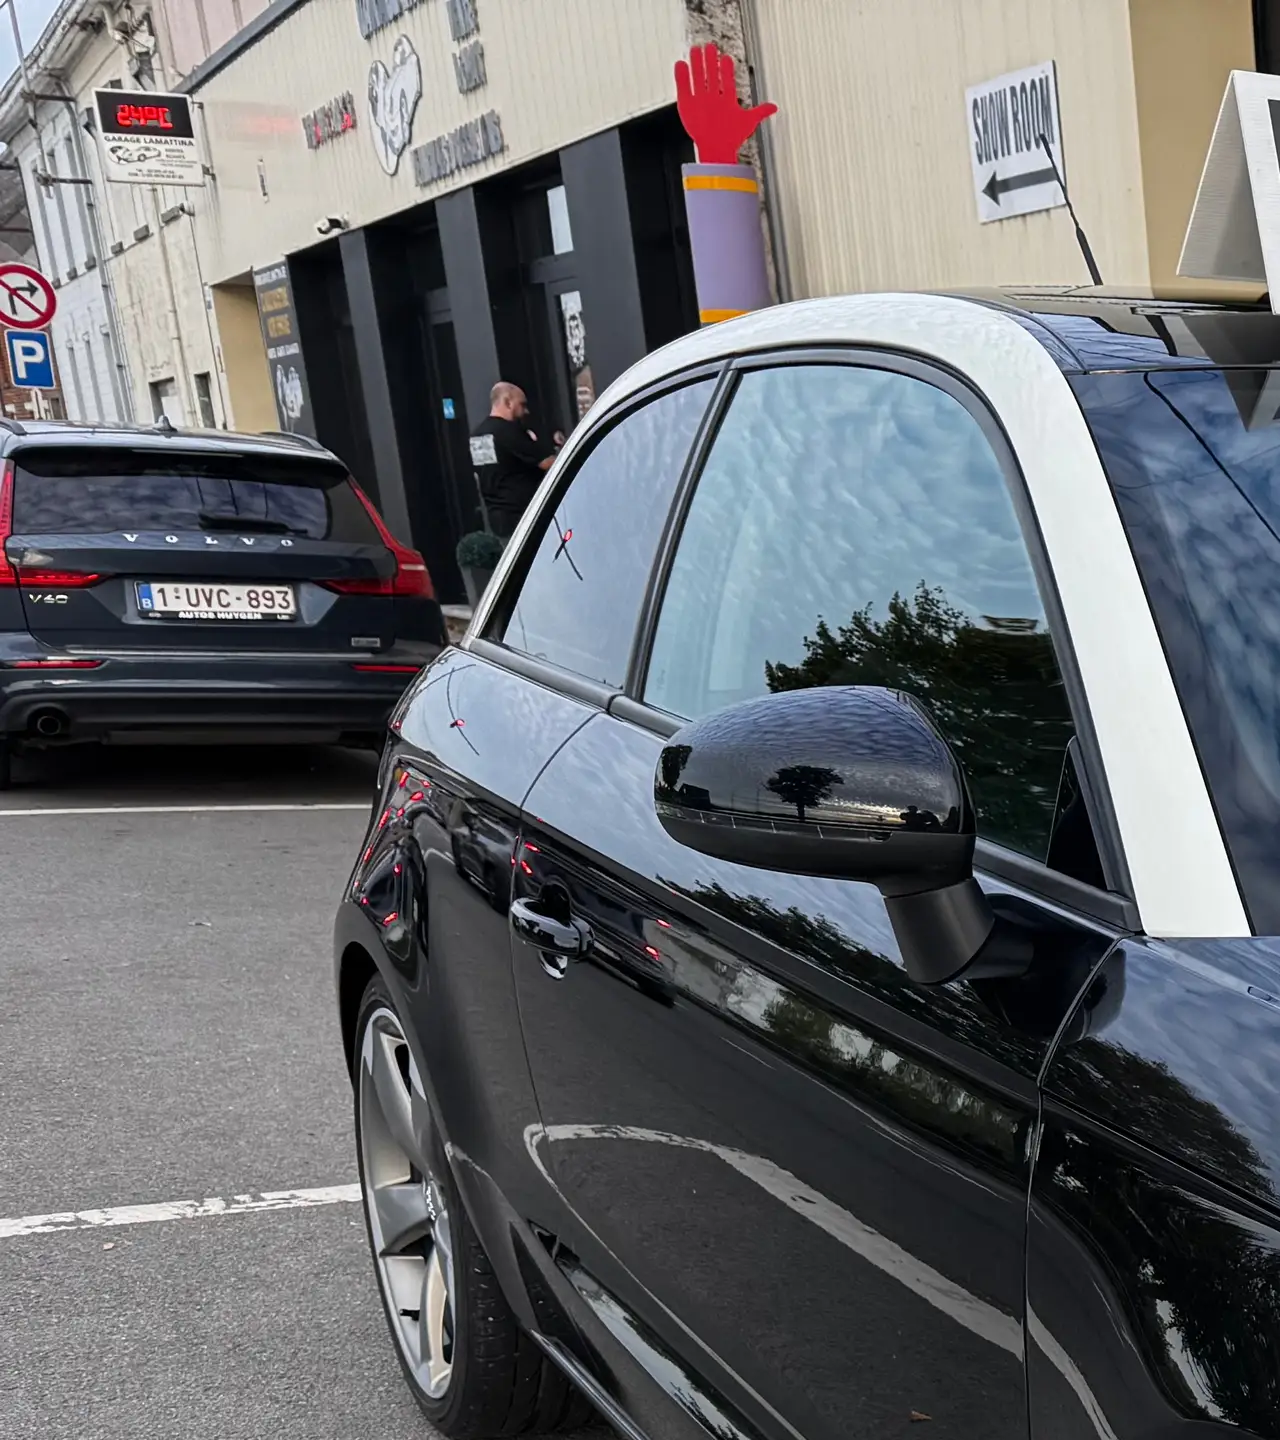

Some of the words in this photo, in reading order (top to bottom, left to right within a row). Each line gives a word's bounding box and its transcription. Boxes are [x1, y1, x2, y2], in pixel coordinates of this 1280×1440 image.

[972, 88, 1011, 165] SHOW
[1010, 75, 1055, 154] ROOM
[104, 135, 141, 144] GARAGE
[143, 137, 195, 147] LAMATTINA
[12, 338, 45, 379] P
[122, 532, 294, 547] VOLVO
[178, 611, 216, 620] AUTOS
